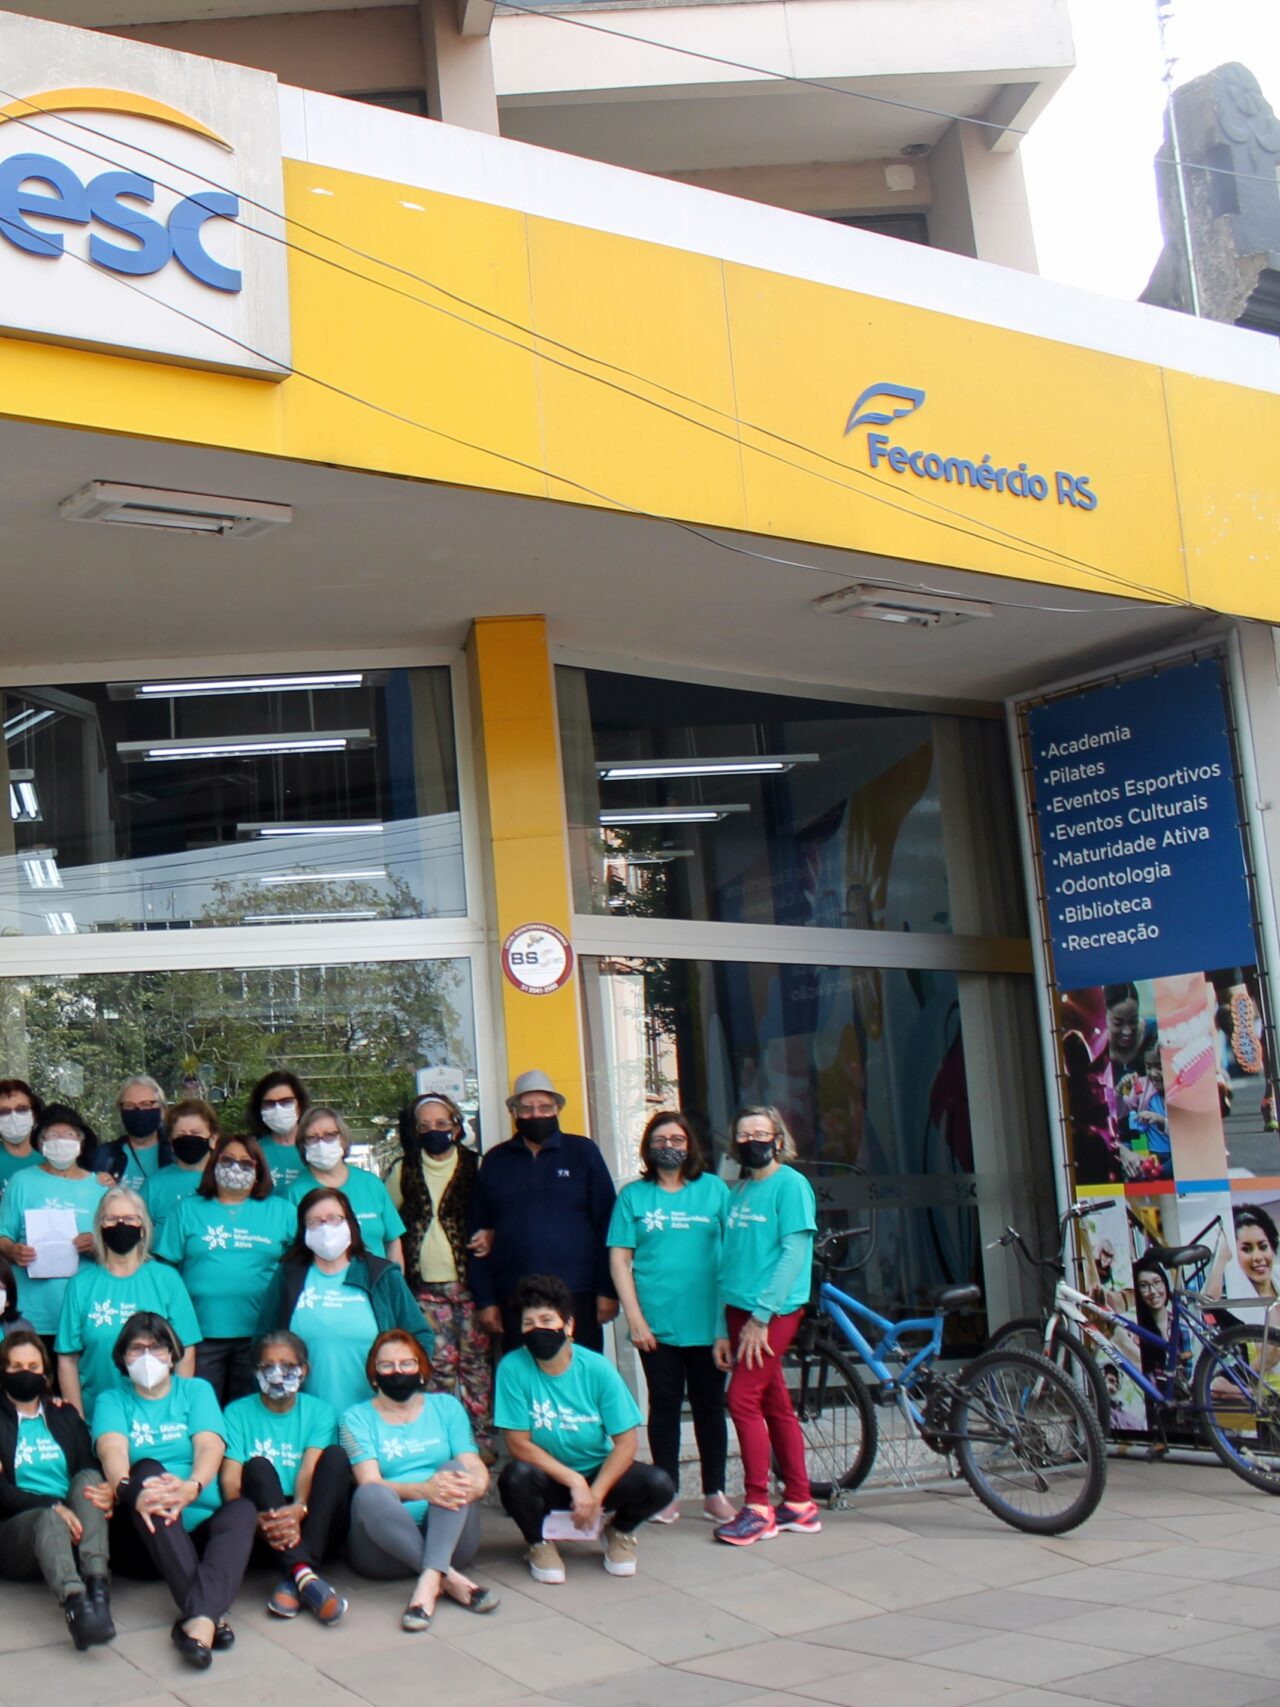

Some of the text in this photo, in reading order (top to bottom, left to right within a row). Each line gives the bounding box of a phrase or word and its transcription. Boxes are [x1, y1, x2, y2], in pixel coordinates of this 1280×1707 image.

[867, 432, 1098, 511] Fecomércio RS
[1047, 725, 1131, 759] Academia
[1050, 761, 1105, 786] Pilates
[1053, 762, 1221, 813] Eventos Esportivos
[1056, 795, 1208, 841] Eventos Culturais
[1059, 825, 1210, 868] Maturidade Ativa
[1062, 862, 1171, 895] Odontologia
[1065, 896, 1152, 923] Biblioteca
[1068, 923, 1159, 951] Recreação
